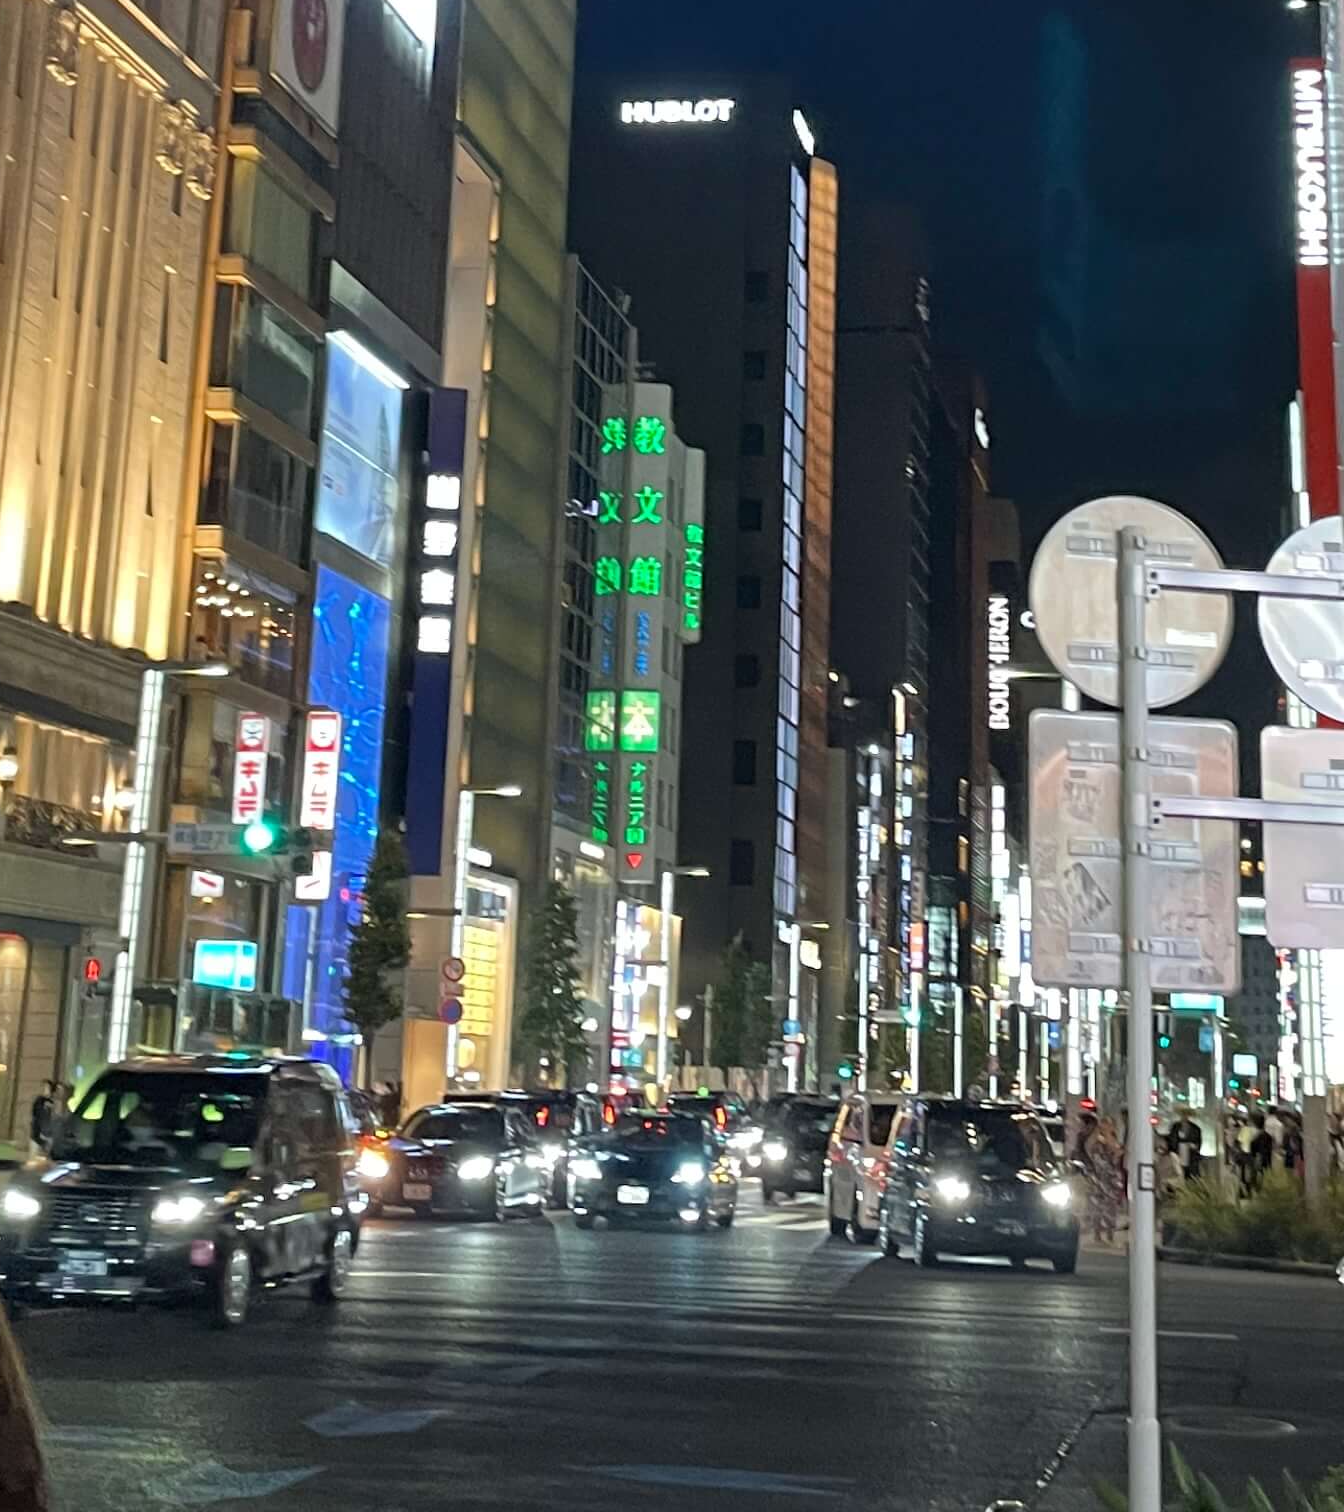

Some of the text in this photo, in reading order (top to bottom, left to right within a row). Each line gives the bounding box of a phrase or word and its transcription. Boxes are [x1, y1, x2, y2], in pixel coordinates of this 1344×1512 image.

[620, 98, 735, 125] HUBLOT
[1293, 68, 1328, 267] MITSUKOSHI
[628, 415, 666, 596] 教文館
[621, 699, 656, 744] 本
